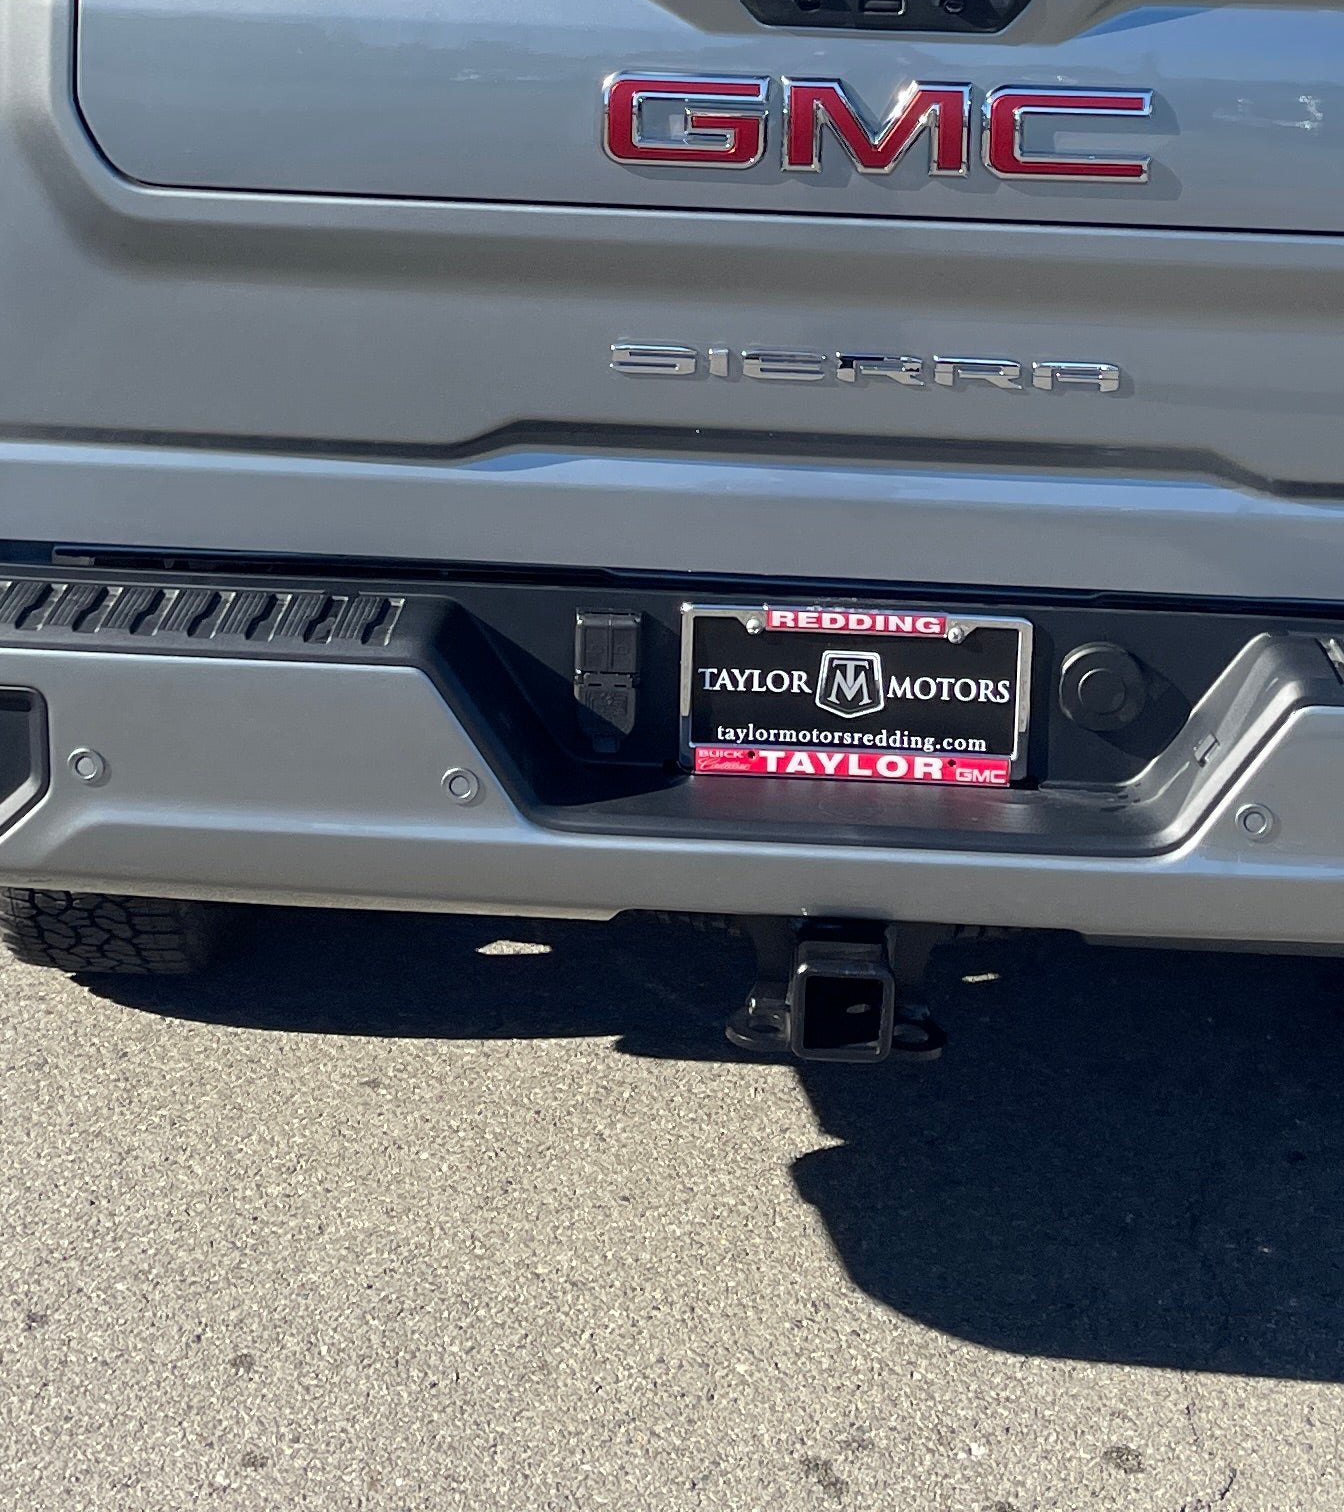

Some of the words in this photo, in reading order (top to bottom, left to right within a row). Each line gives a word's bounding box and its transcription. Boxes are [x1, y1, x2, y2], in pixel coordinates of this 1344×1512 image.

[601, 70, 1156, 183] GMC
[609, 343, 1121, 393] SIERRA
[771, 610, 942, 634] REDDING
[697, 668, 813, 694] TAYLOR
[886, 675, 1010, 704] MOTORS
[717, 723, 987, 752] taylormotorsredding.com
[697, 749, 745, 759] BUICK
[758, 750, 943, 780] TAYLOR
[955, 768, 1006, 784] GMC
